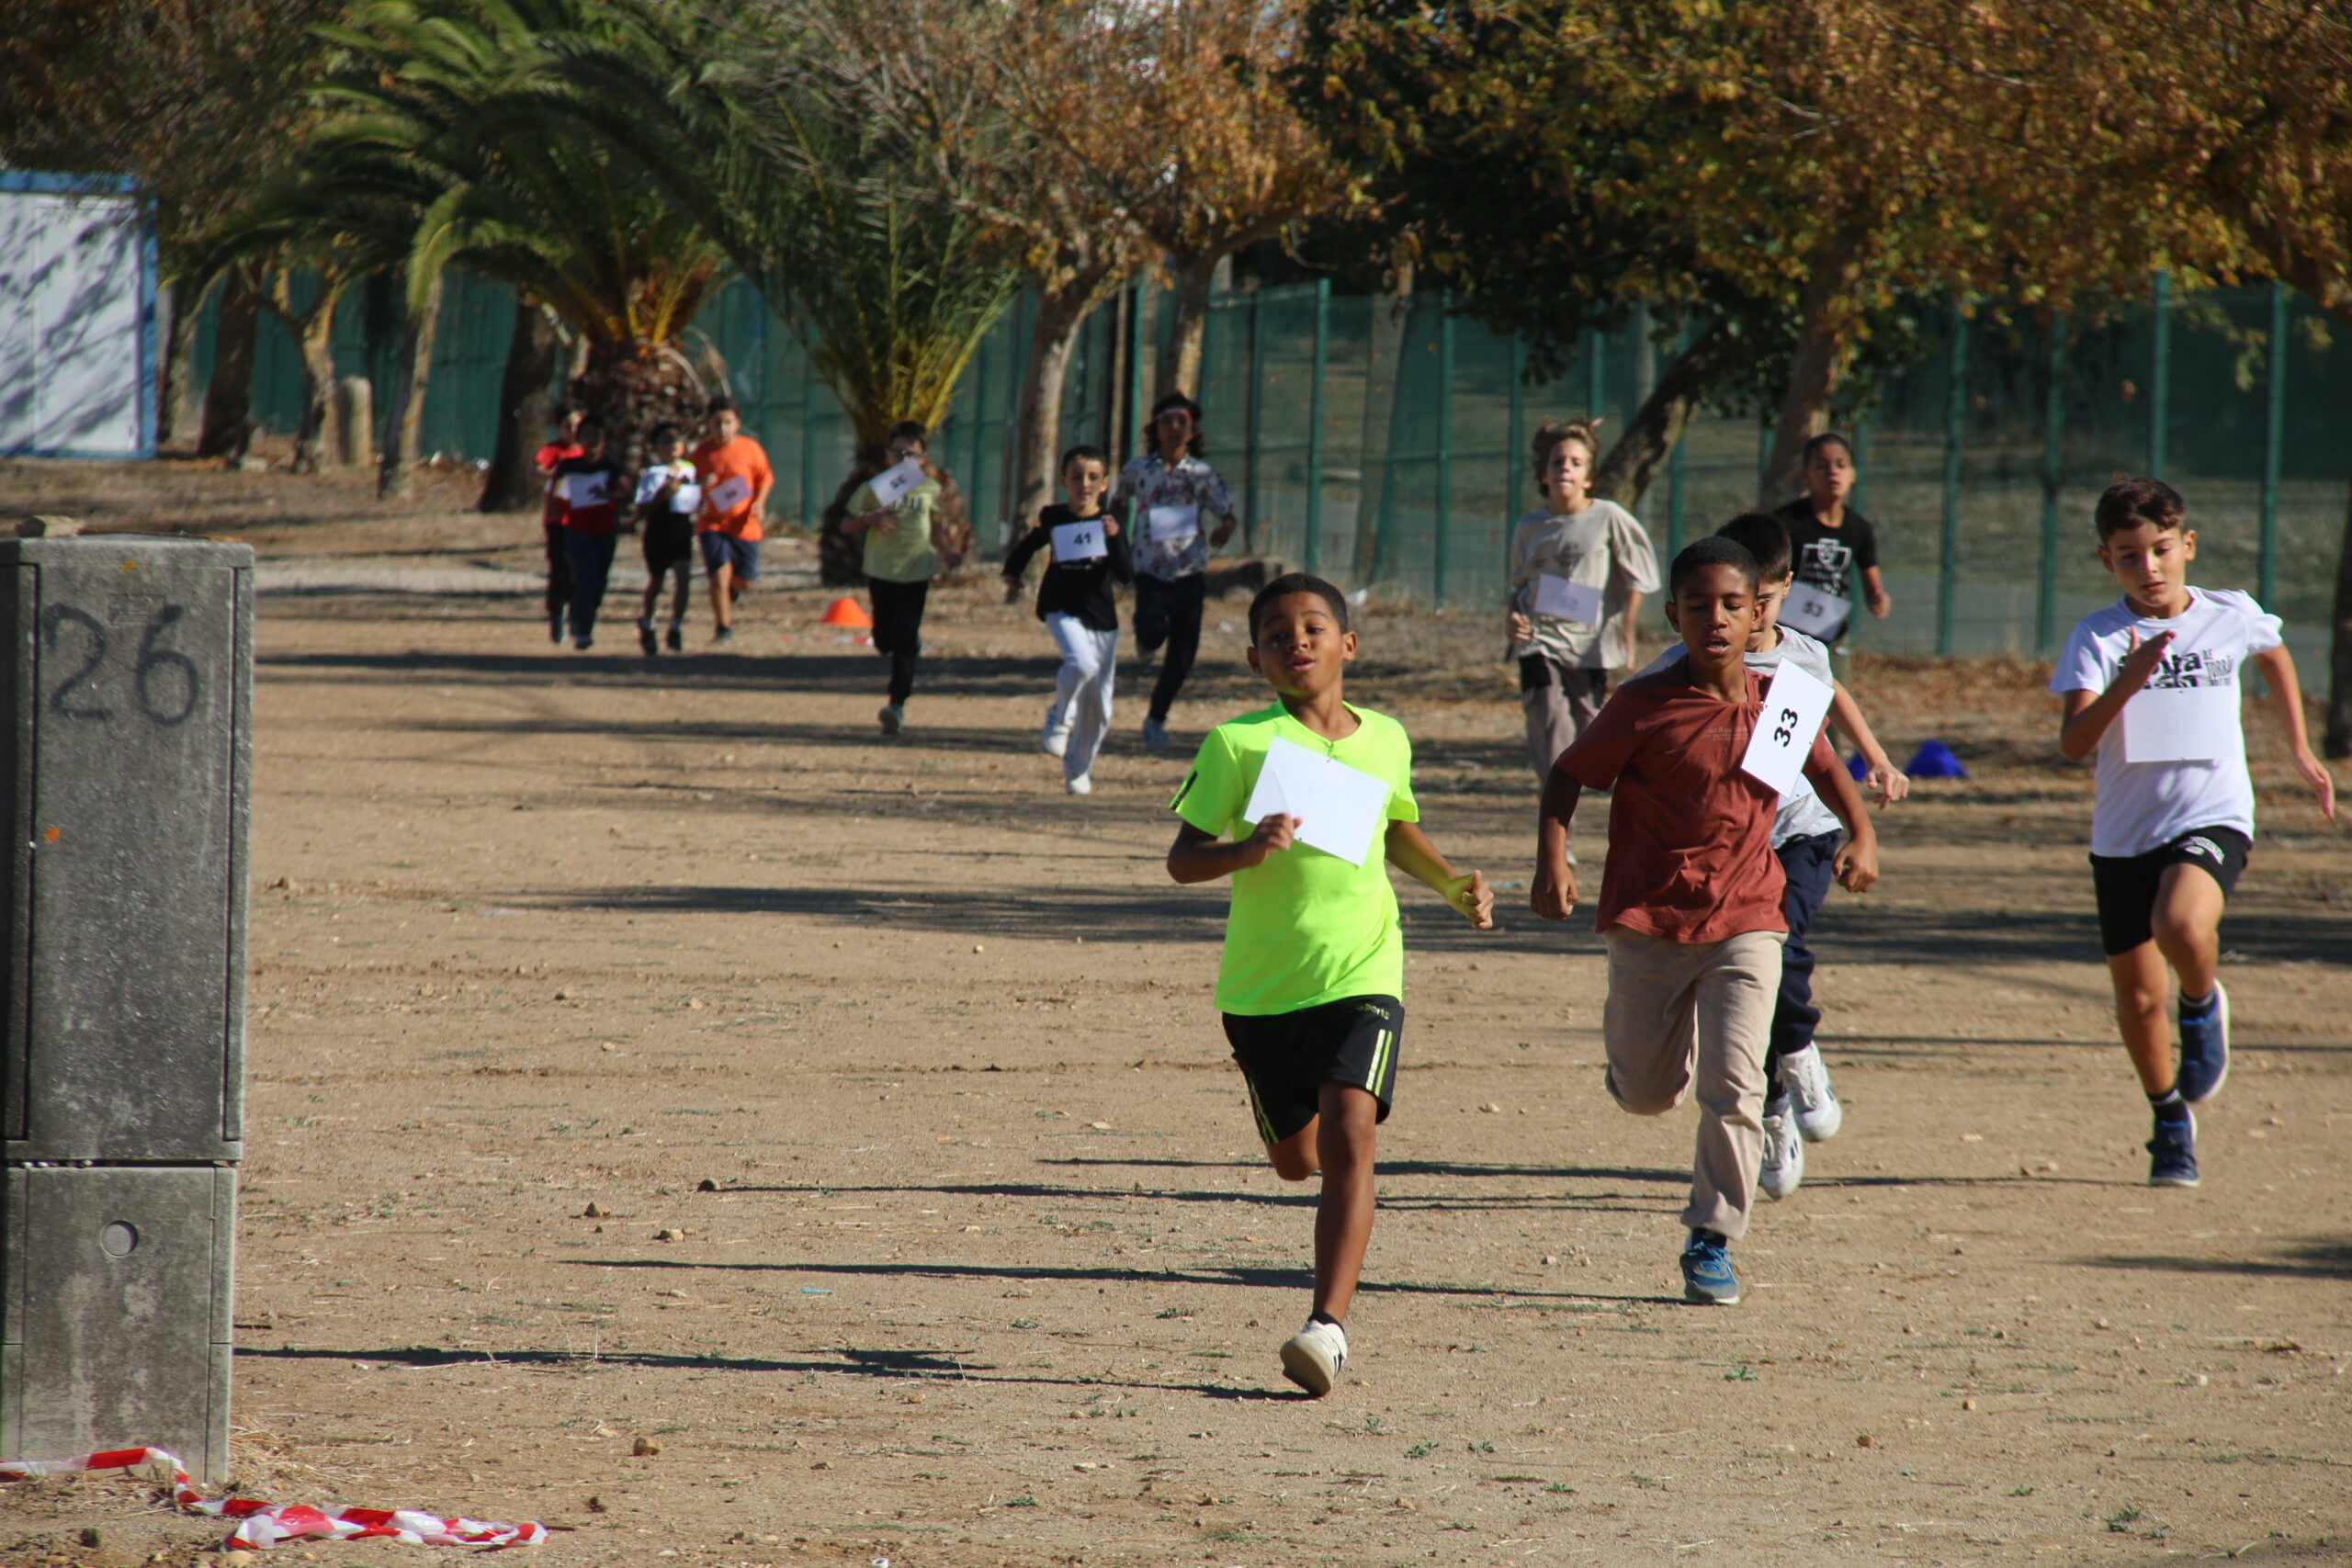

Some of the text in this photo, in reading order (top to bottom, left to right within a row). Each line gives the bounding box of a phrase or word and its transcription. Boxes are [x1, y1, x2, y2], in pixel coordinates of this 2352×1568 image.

[1073, 532, 1091, 546] 41
[41, 602, 201, 728] 26
[1774, 707, 1798, 748] 33
